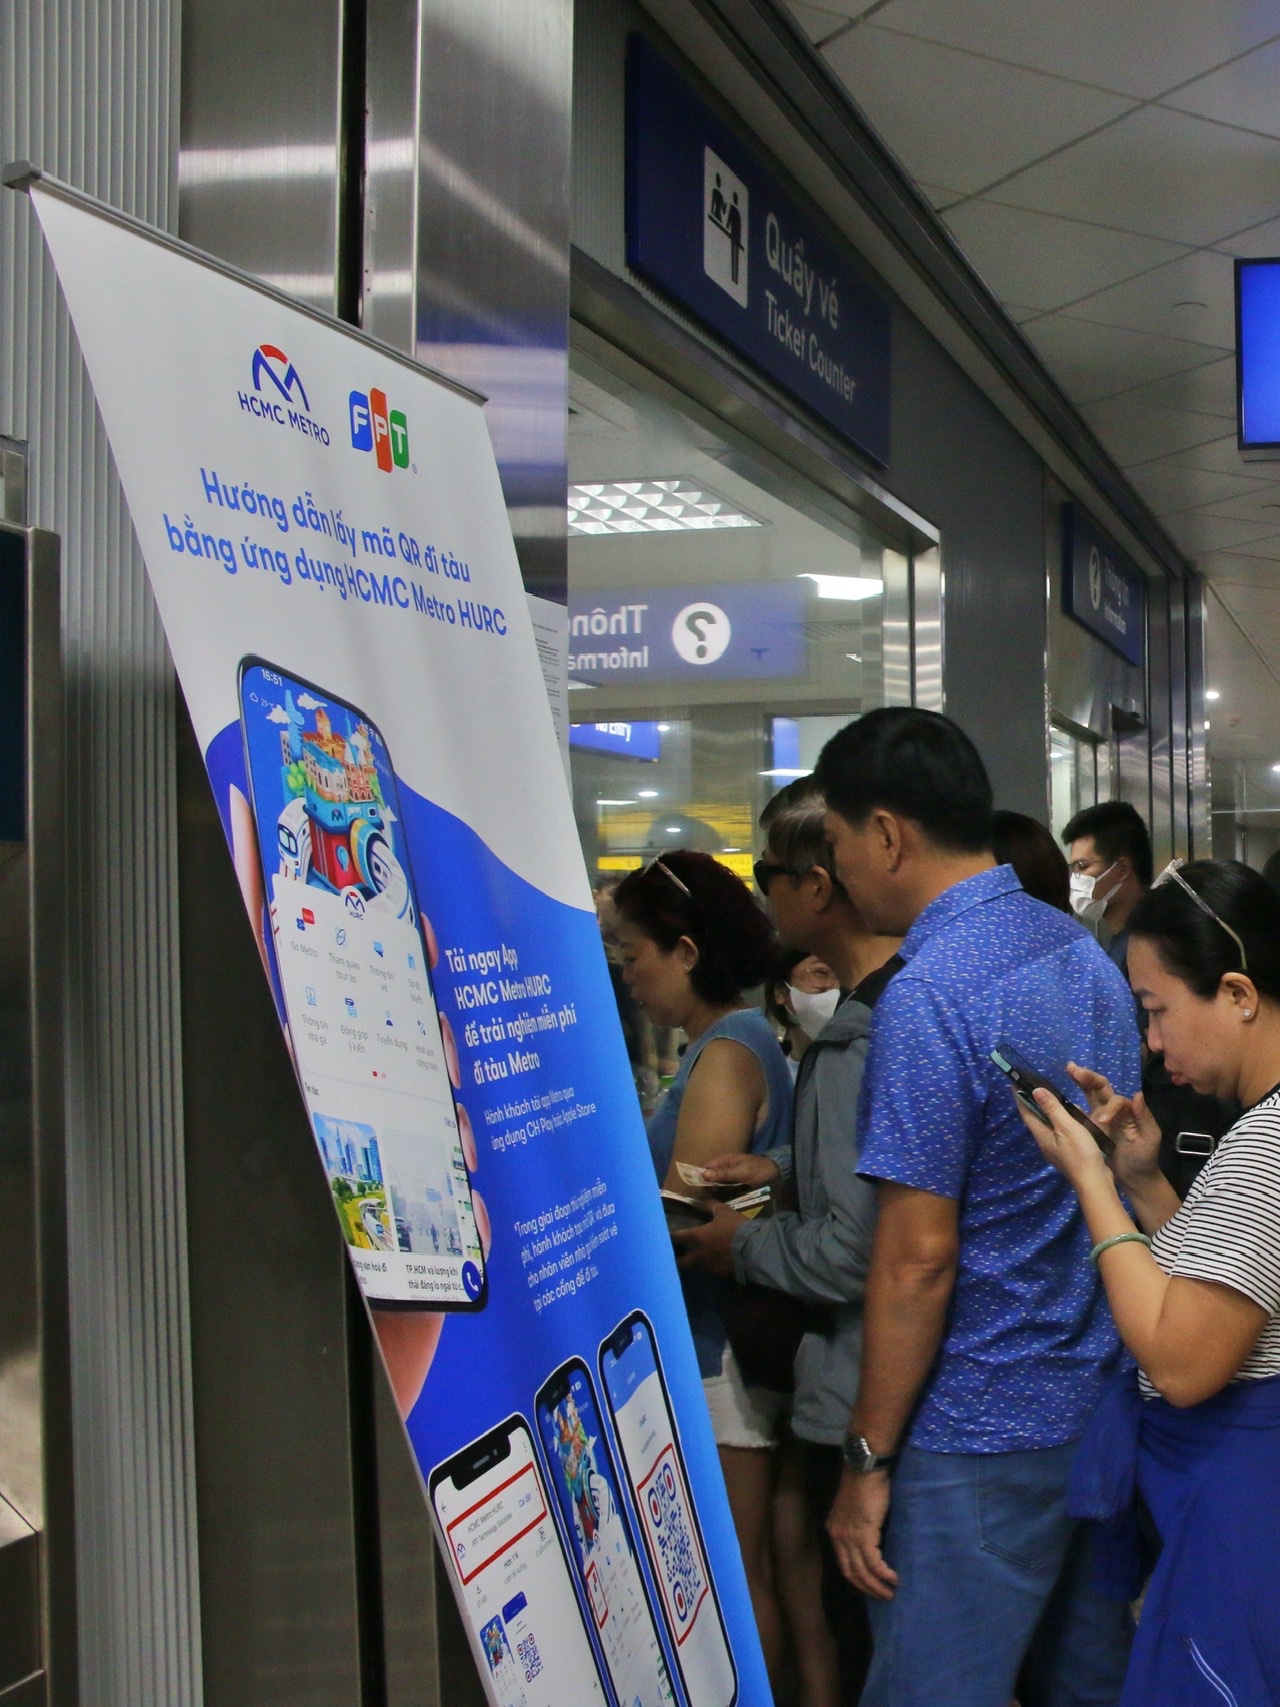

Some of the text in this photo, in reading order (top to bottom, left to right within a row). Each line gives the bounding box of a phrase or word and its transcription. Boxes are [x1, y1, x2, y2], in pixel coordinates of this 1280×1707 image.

[819, 278, 840, 329] vé
[765, 290, 856, 404] Ticket Counter
[238, 391, 330, 446] HCMC METRO
[351, 402, 408, 458] FPT
[200, 467, 471, 582] Hướng dẫn lấy mã QR đi tàu
[163, 514, 507, 636] bằng ứng dụng HCMC Metro HURC
[261, 669, 283, 687] 16:51
[445, 944, 518, 975] Tải ngay App
[455, 974, 552, 1010] HCMC Metro HURC
[465, 1002, 577, 1048] để trải nghiệm miễn phí
[473, 1051, 540, 1085] đi tàu Metro
[484, 1106, 505, 1126] Hành
[504, 1098, 532, 1119] khách
[505, 1129, 527, 1148] dụng
[527, 1120, 541, 1137] CH
[540, 1115, 555, 1134] Play
[562, 1107, 577, 1127] Apple
[576, 1103, 597, 1118] Store
[538, 1208, 554, 1232] giai
[552, 1224, 576, 1247] khách
[528, 1271, 539, 1288] cho
[539, 1261, 559, 1282] nhân
[542, 1289, 556, 1306] các
[555, 1279, 577, 1296] cổng
